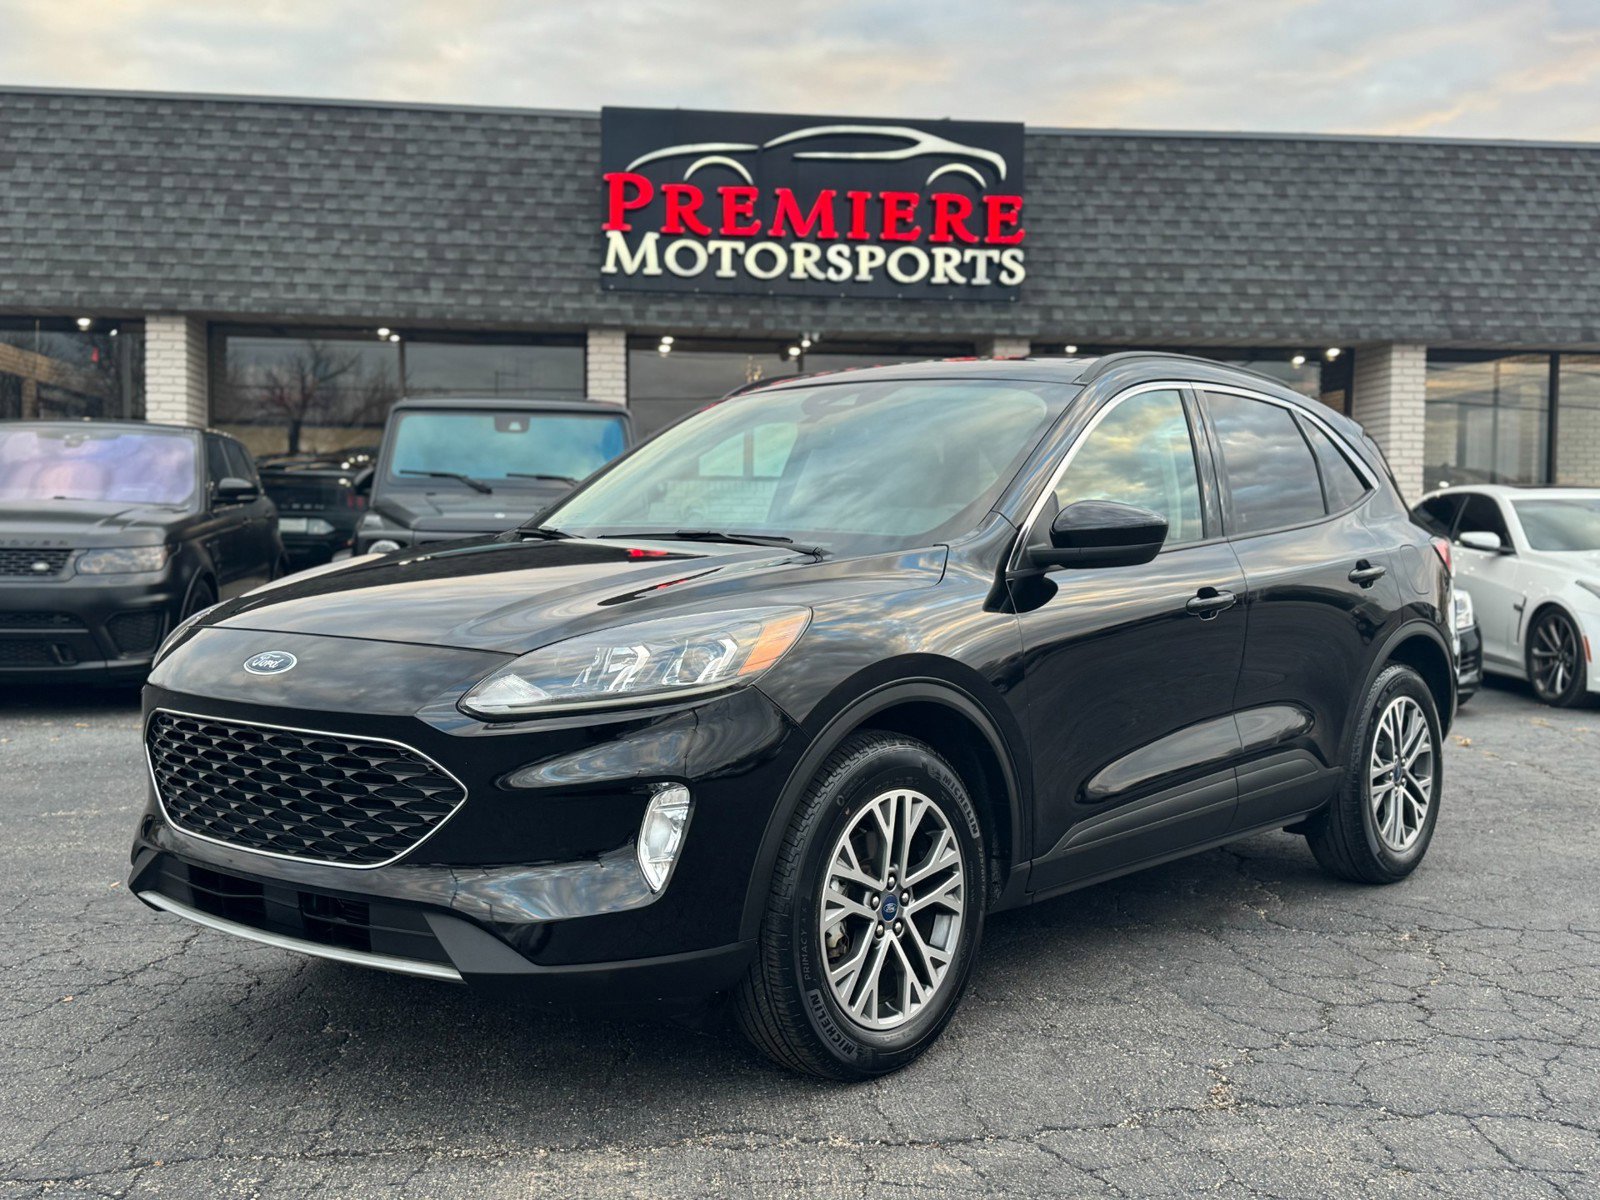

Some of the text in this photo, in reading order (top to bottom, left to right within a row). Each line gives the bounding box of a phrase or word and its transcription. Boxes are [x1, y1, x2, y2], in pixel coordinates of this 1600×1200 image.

[602, 172, 1026, 245] PREMIERE
[600, 230, 1026, 286] MOTORSPORTS
[941, 773, 980, 835] MICHELIN
[800, 929, 812, 981] PRIMACY
[809, 992, 857, 1057] MICHELIN
